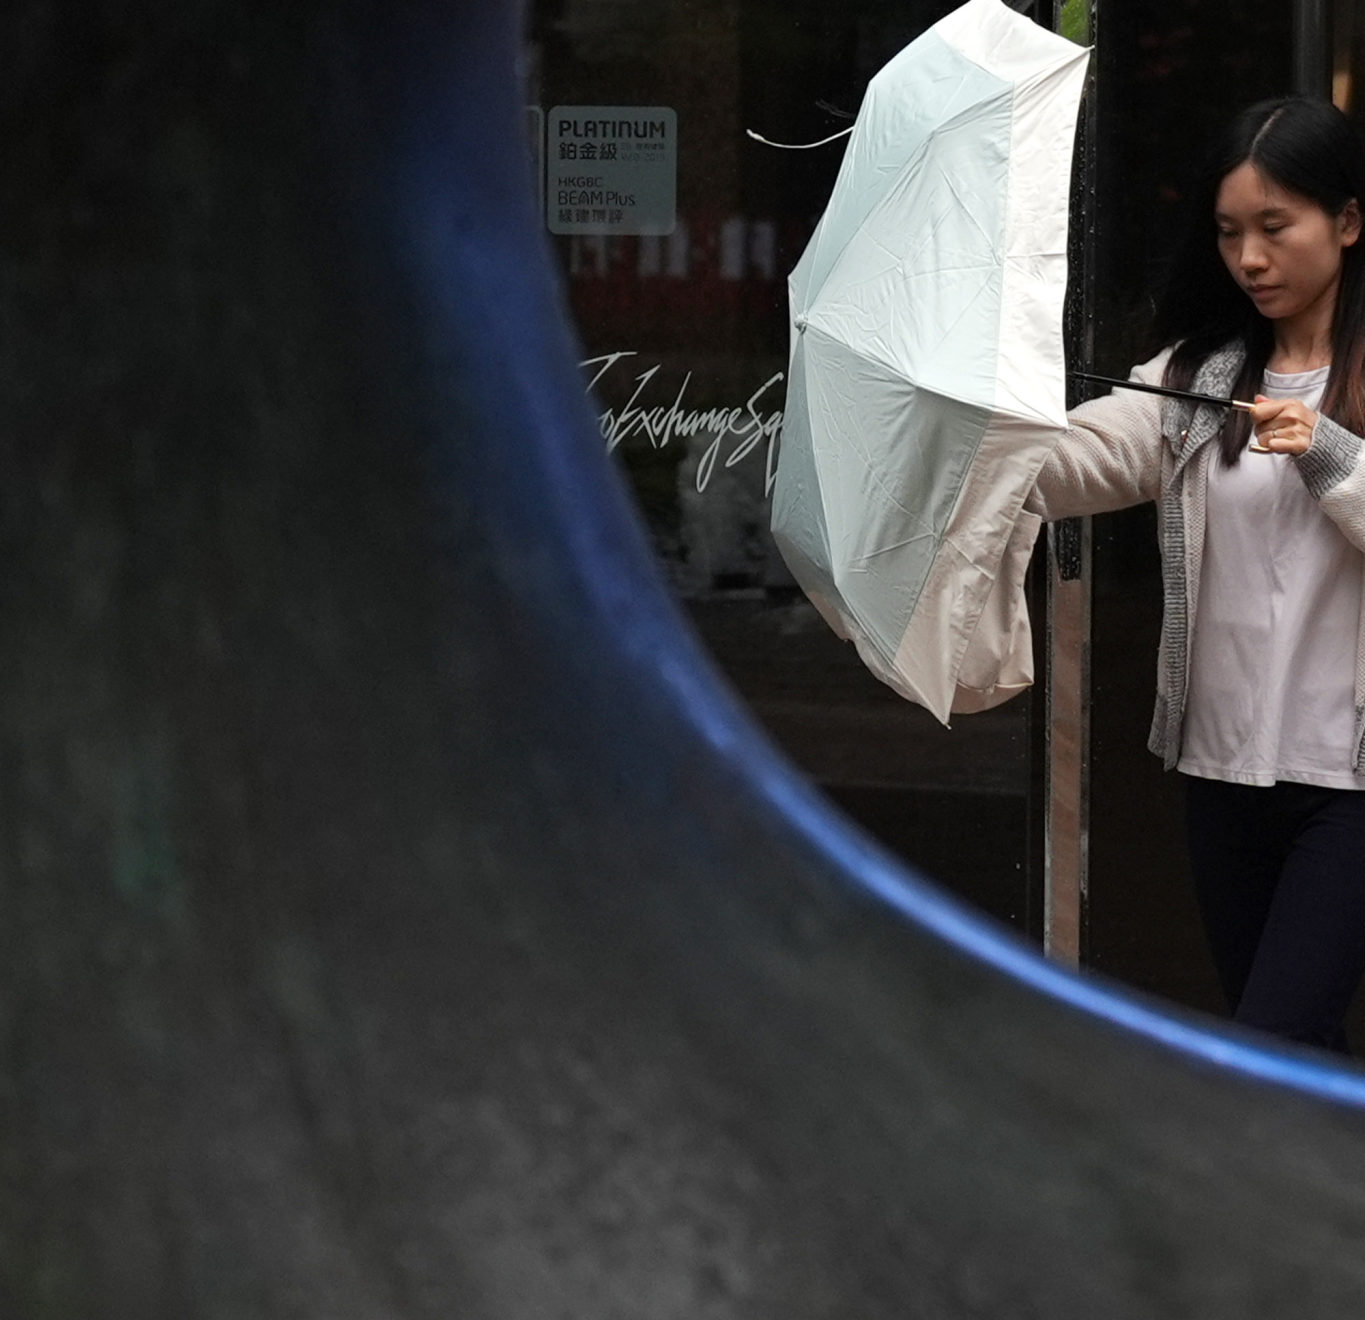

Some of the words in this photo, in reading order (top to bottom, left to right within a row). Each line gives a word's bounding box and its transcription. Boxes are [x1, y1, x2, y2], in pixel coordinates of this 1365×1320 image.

[558, 120, 666, 138] PLATINUM
[559, 142, 617, 160] 鉑金級
[558, 190, 603, 205] BEAM
[605, 191, 637, 206] Plus
